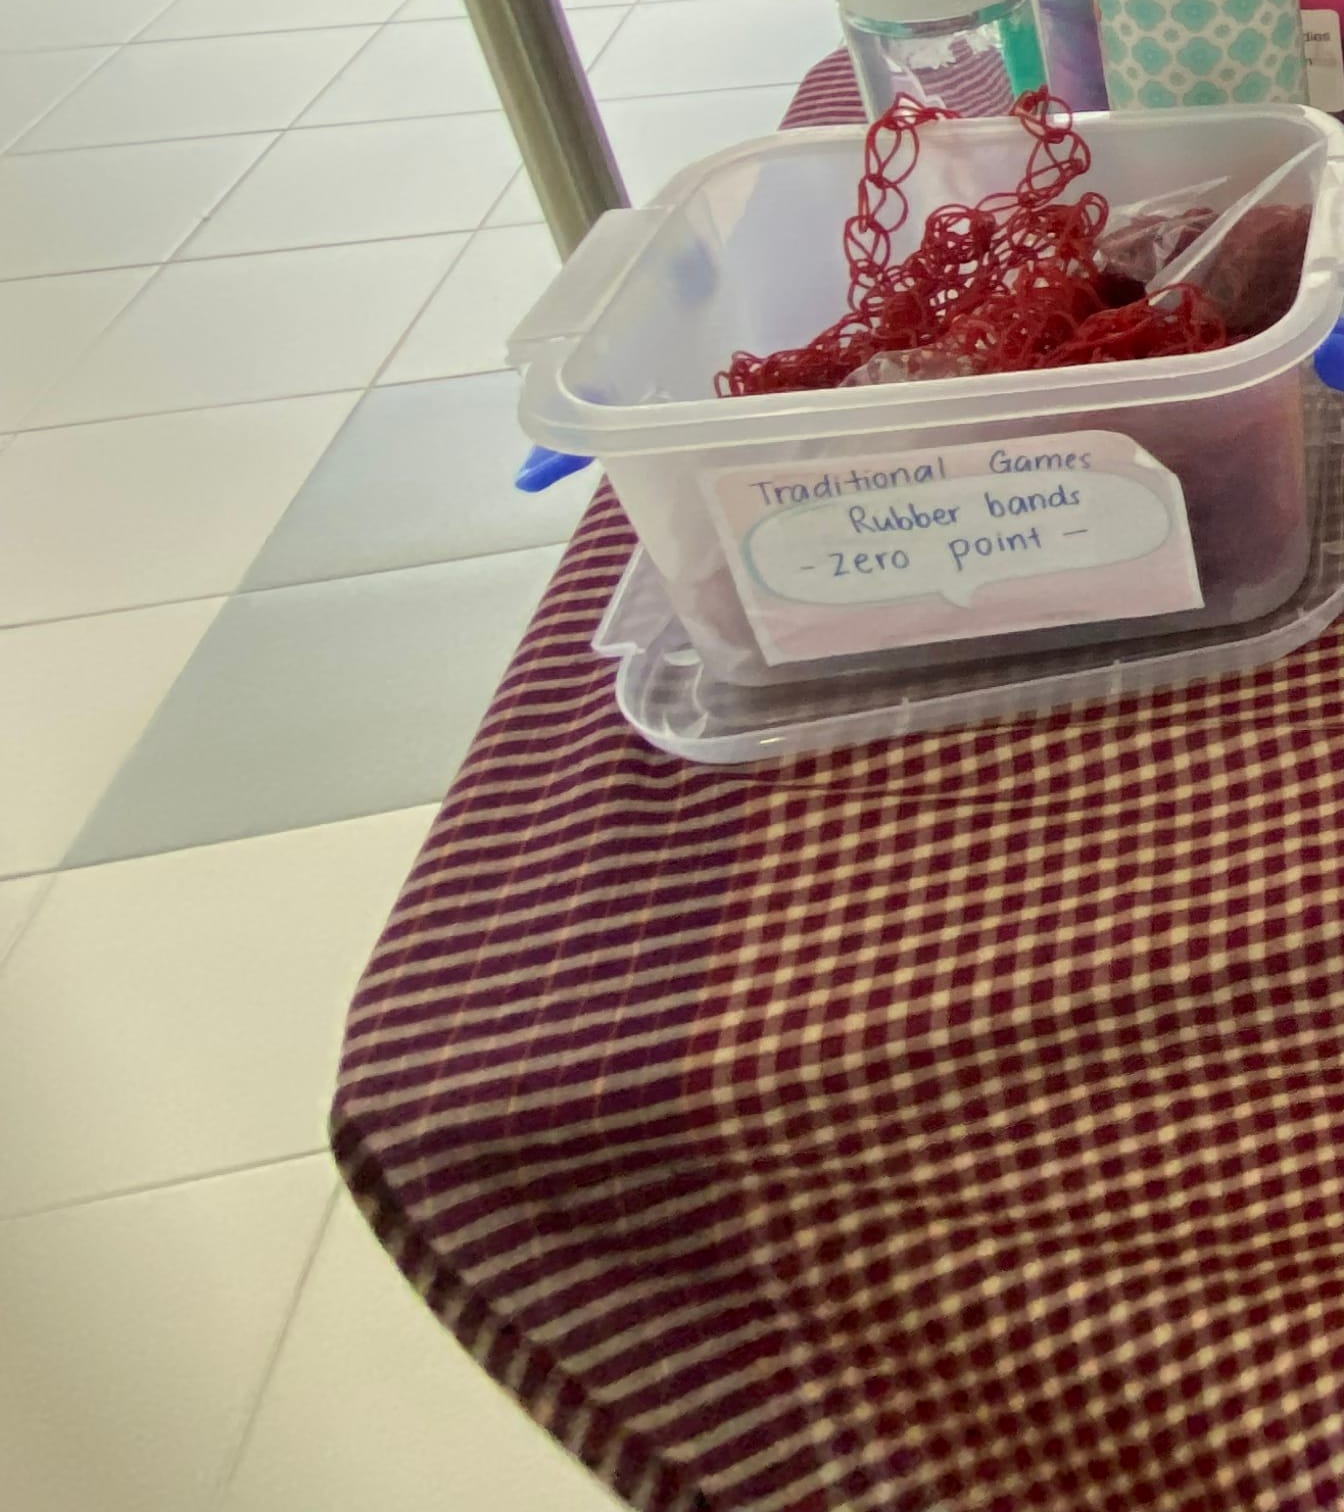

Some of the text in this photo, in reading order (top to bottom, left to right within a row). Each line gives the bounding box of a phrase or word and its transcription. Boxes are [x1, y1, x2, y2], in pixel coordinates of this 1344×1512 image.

[751, 449, 1091, 506] Traditional Games
[849, 484, 1080, 534] Rubber bands
